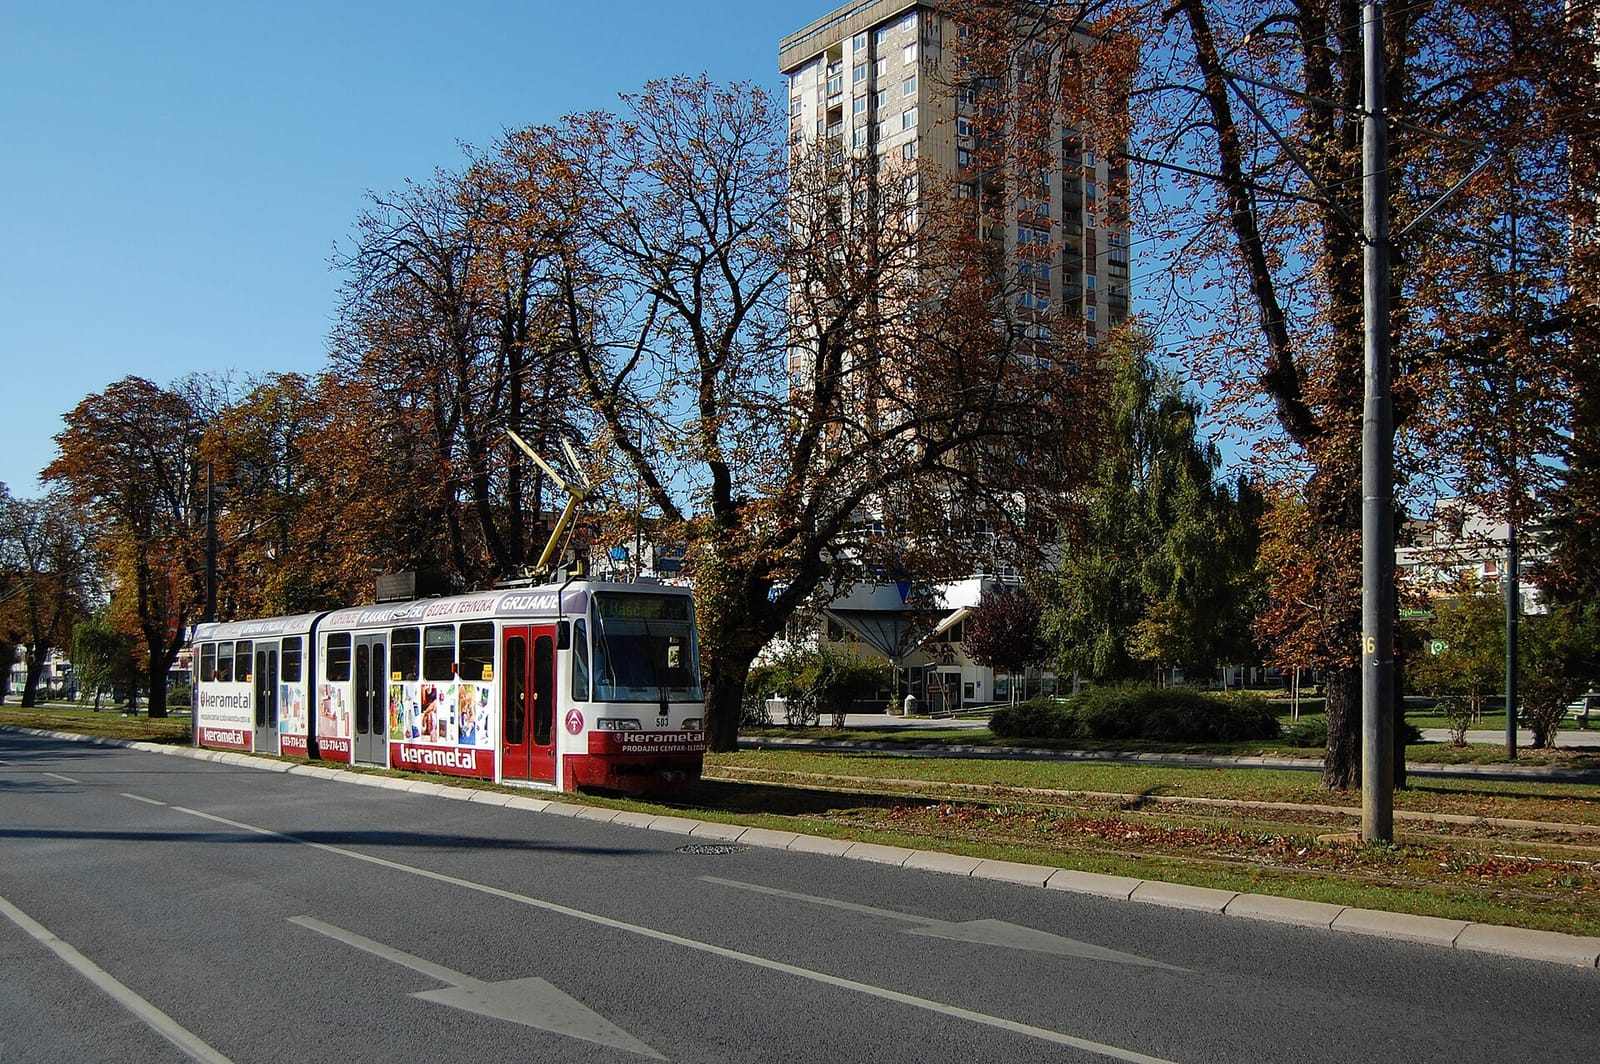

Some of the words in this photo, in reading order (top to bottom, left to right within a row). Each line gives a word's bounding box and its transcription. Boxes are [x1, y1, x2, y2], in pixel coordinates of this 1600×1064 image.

[427, 603, 453, 617] BIJELA
[455, 599, 495, 614] TEHNIKA
[501, 595, 558, 610] GRIJANJE
[206, 691, 251, 709] kerametal
[204, 728, 245, 745] kerametal
[623, 731, 705, 743] kerametal
[400, 743, 477, 770] kerametal
